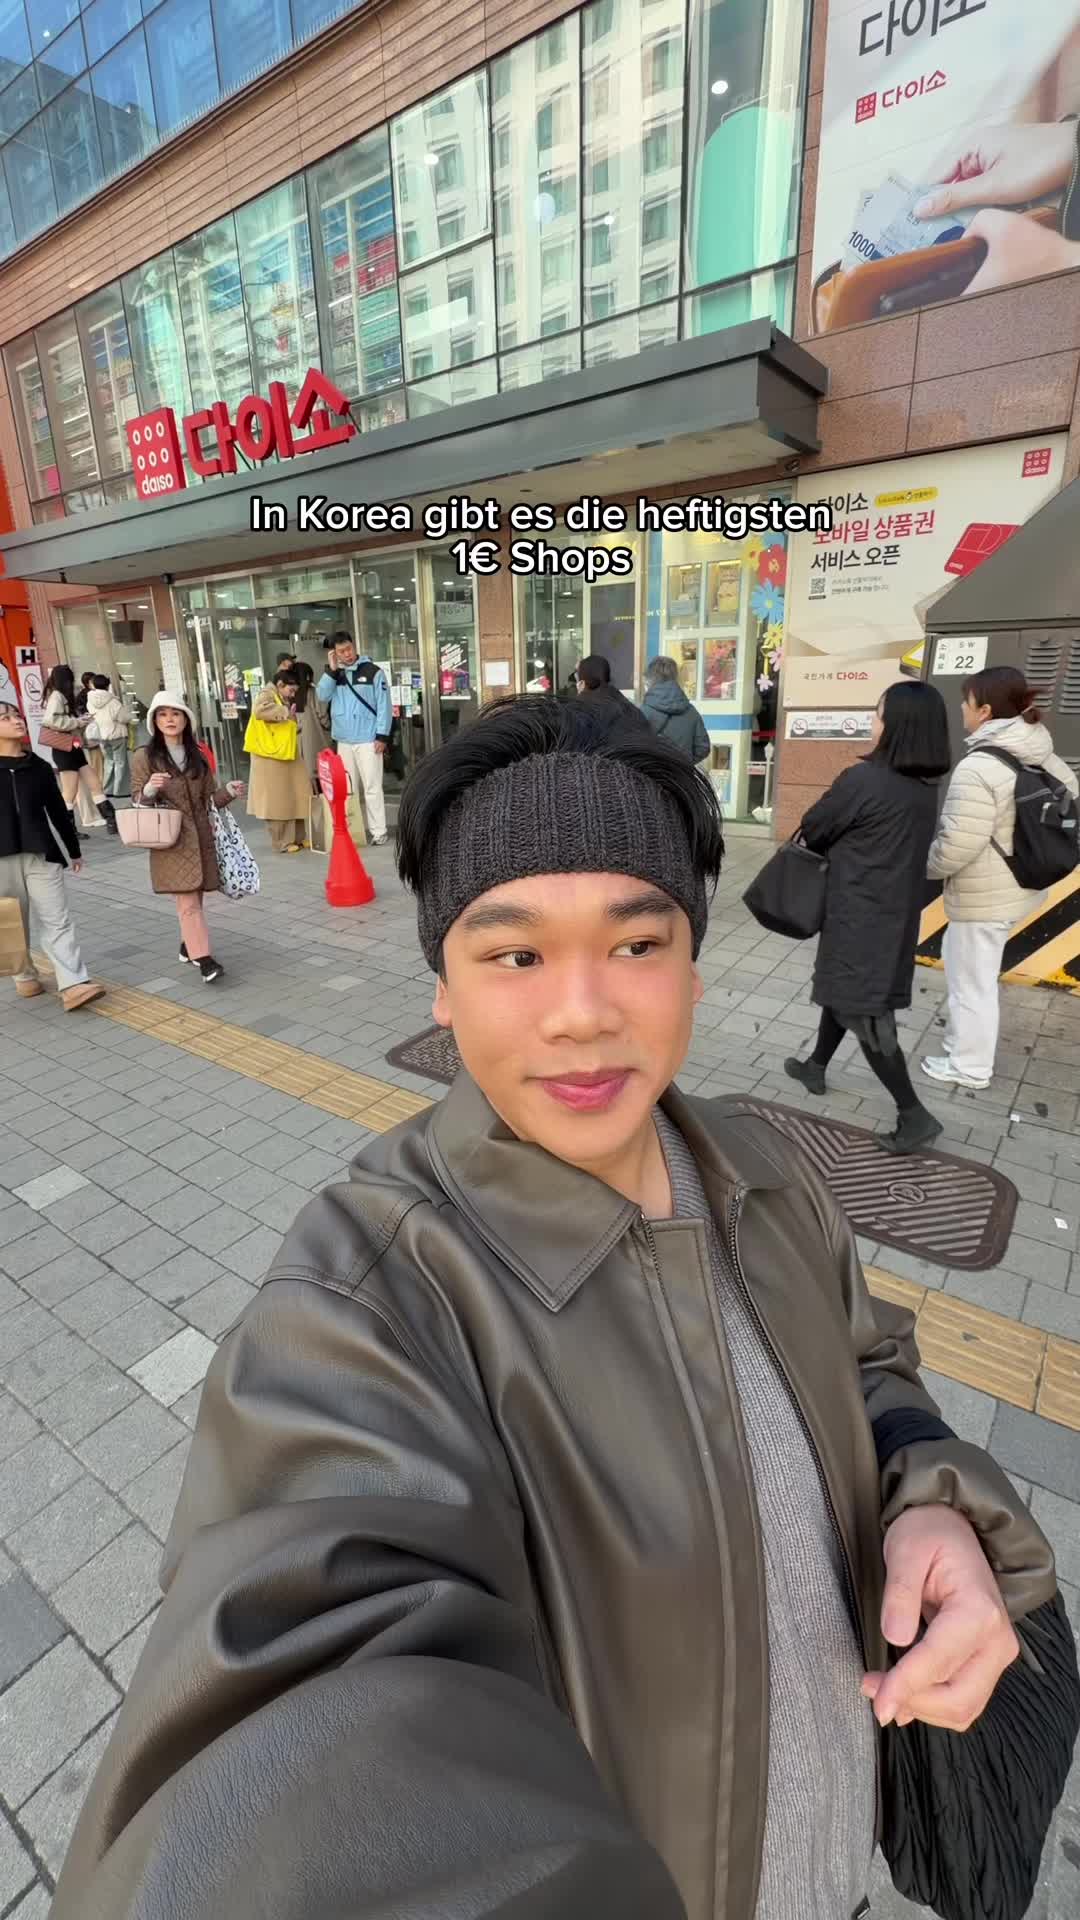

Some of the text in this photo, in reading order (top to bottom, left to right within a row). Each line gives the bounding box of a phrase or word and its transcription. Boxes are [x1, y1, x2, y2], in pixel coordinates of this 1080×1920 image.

[882, 70, 947, 108] 다이소
[182, 367, 356, 477] 다이소
[142, 473, 173, 495] daiso
[874, 510, 936, 540] 상품권
[811, 544, 902, 573] 서비스 오픈
[836, 671, 869, 681] 다이소
[955, 655, 975, 669] 22
